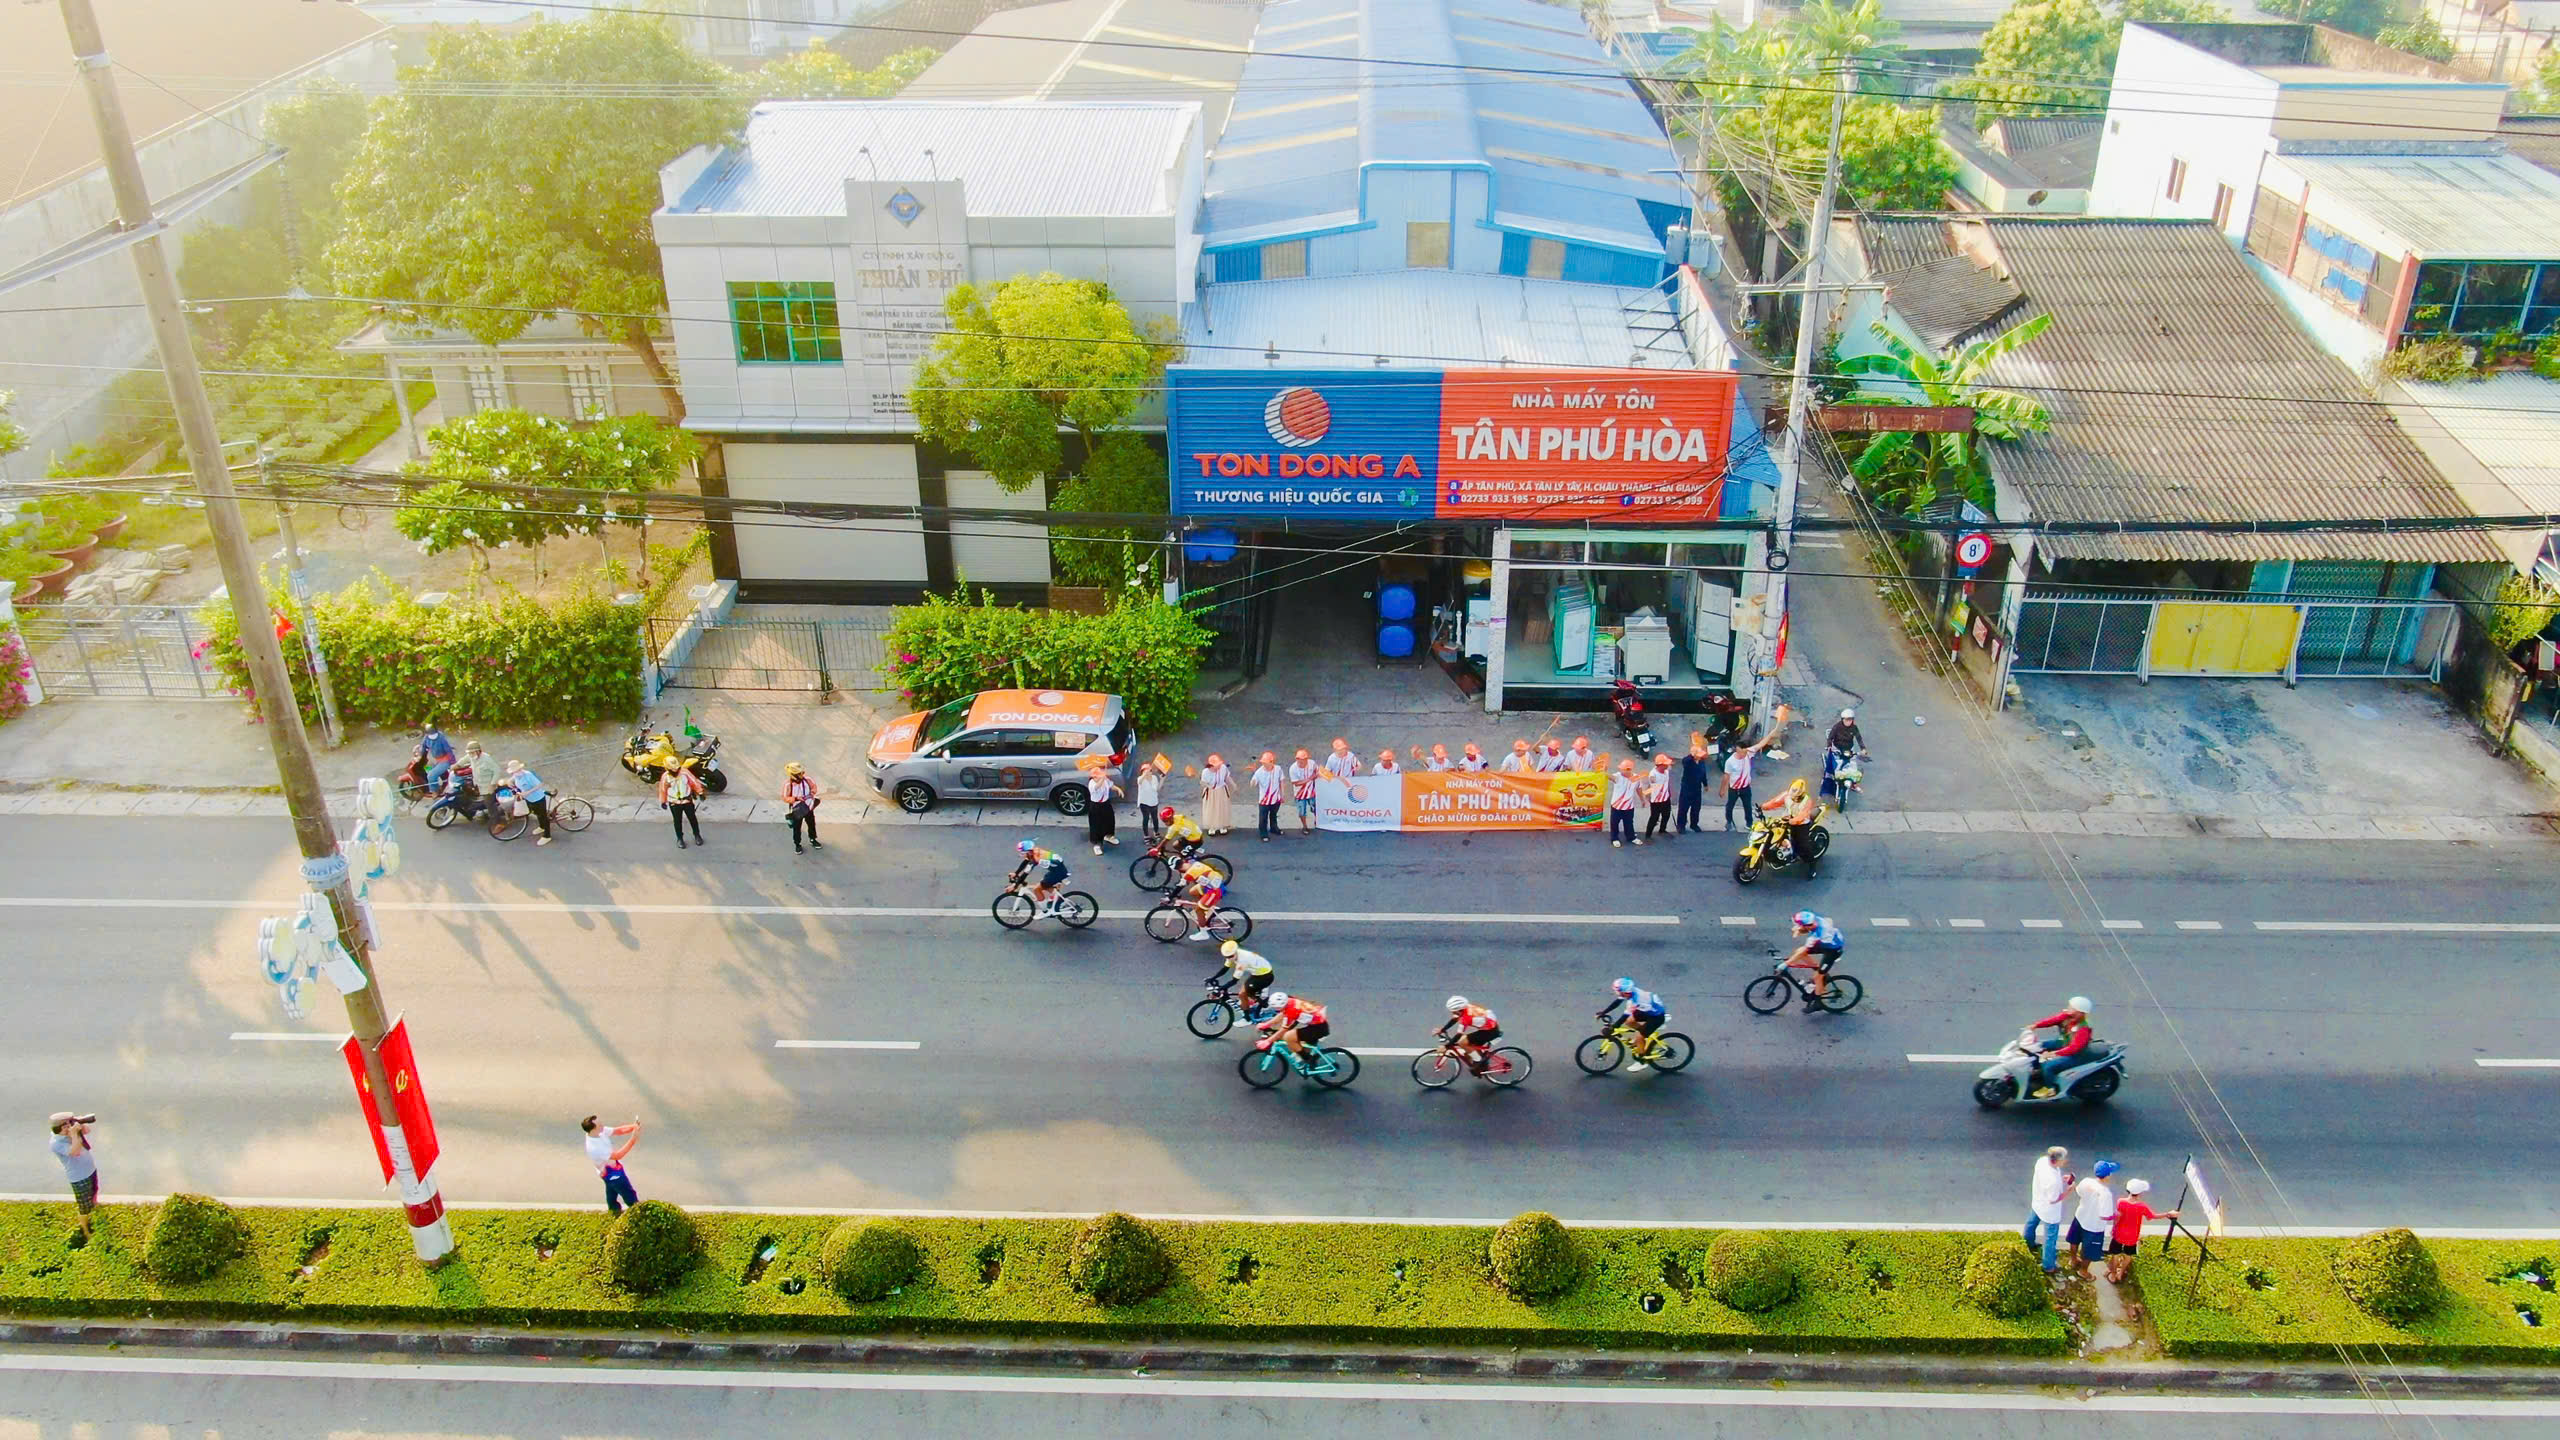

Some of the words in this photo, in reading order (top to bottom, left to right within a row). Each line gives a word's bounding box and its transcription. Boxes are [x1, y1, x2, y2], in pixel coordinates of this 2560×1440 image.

[1512, 387, 1555, 409] NHÀ
[1563, 387, 1607, 409] MÁY
[1615, 387, 1656, 410] TÔN
[1451, 417, 1531, 461] TÂN
[1539, 417, 1617, 462] PHÚ
[1623, 417, 1708, 462] HÒA
[1193, 453, 1271, 478] TON
[1279, 453, 1384, 479] DONG
[1393, 454, 1422, 479] A
[1476, 480, 1494, 491] TÂN
[1535, 481, 1553, 491] TÂN
[1194, 489, 1265, 503] THƯƠNG
[1269, 488, 1304, 507] HIỆU
[1308, 487, 1352, 506] QUỐC
[1356, 491, 1384, 504] GIA
[1461, 494, 1489, 503] 02733
[1492, 494, 1509, 504] 933
[1512, 494, 1529, 504] 195
[1634, 495, 1664, 505] 02733
[989, 712, 1025, 722] TON
[1027, 712, 1079, 722] DONG
[1080, 715, 1095, 724] A
[1446, 779, 1465, 789] NHÀ
[1466, 778, 1482, 789] MÁY
[1485, 779, 1503, 788] TÔN
[1417, 790, 1451, 811] TÂN
[1457, 789, 1491, 810] PHÚ
[1498, 789, 1532, 810] HÒA
[1324, 808, 1348, 816] TON
[1349, 809, 1382, 818] DONG
[1383, 808, 1392, 817] A
[1417, 813, 1445, 823] CHÀO
[1447, 812, 1478, 822] MỪNG
[1480, 812, 1508, 822] ĐOÀN
